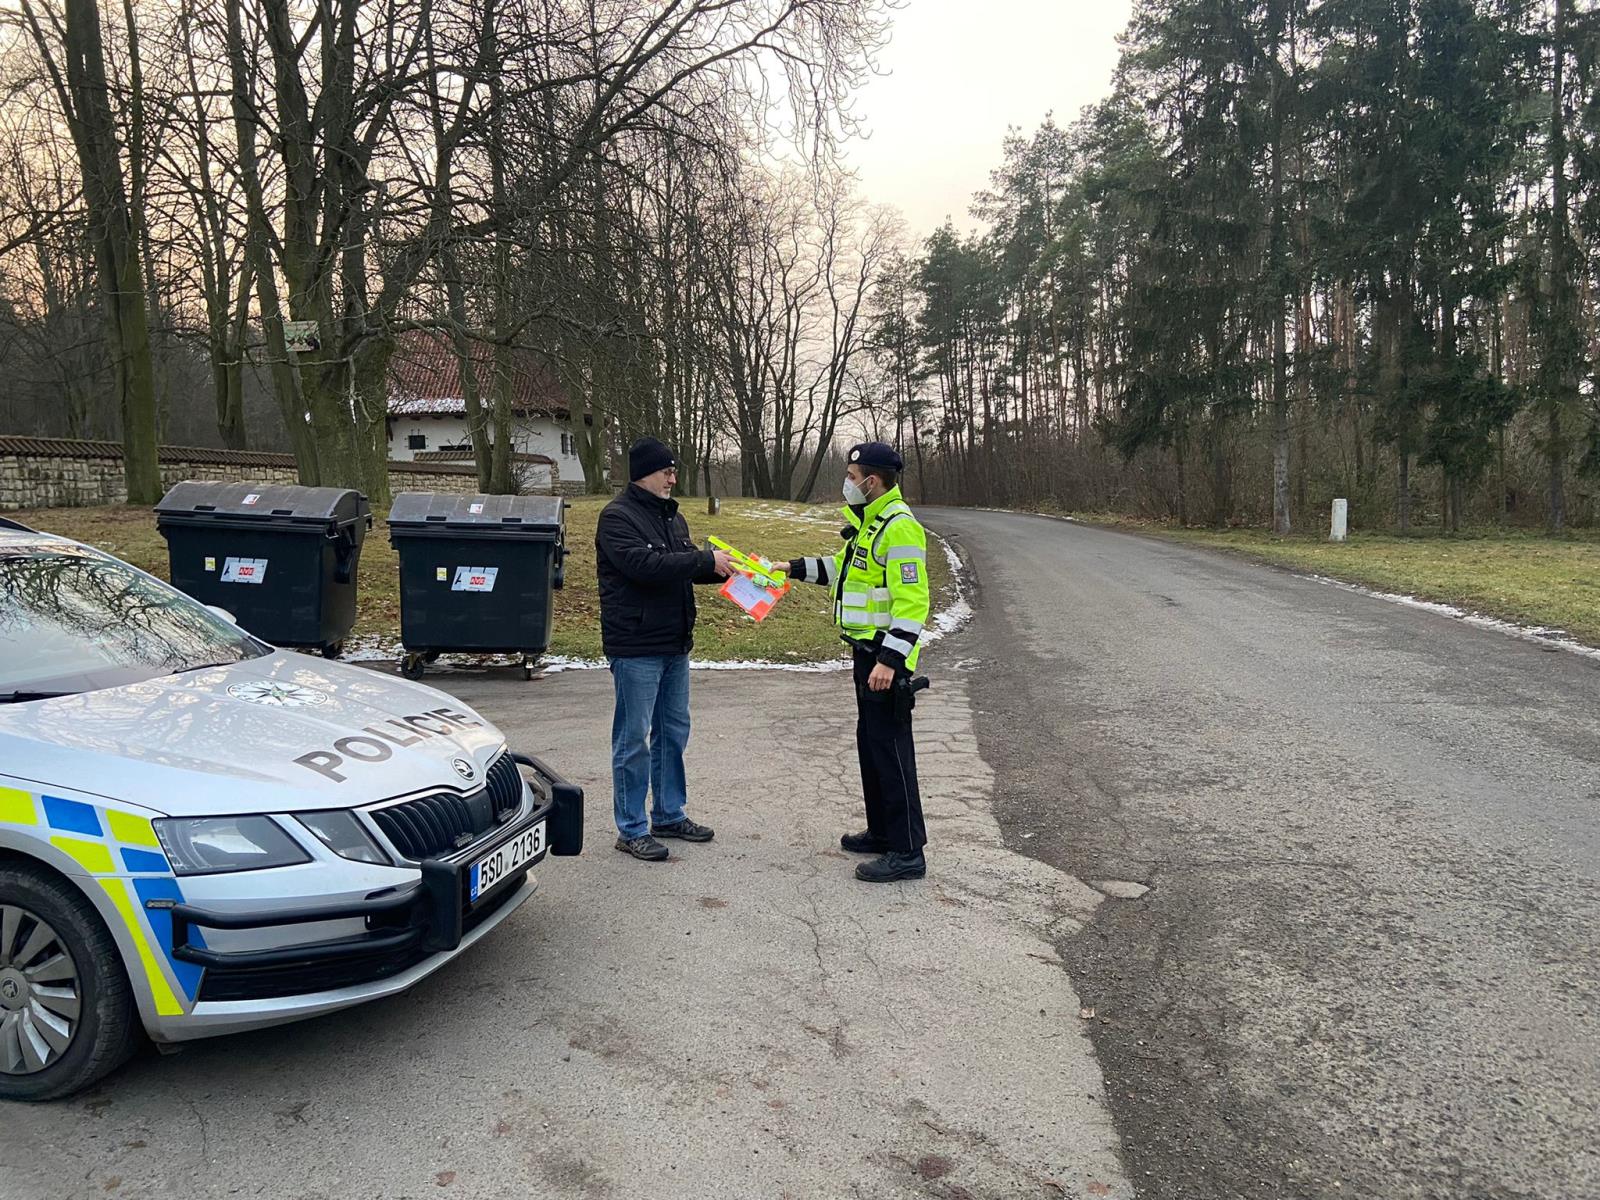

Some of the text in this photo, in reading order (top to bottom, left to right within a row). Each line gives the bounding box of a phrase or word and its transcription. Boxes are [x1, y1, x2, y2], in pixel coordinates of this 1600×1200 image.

[292, 708, 484, 784] POLICIE
[481, 828, 540, 889] 5SD 2136
